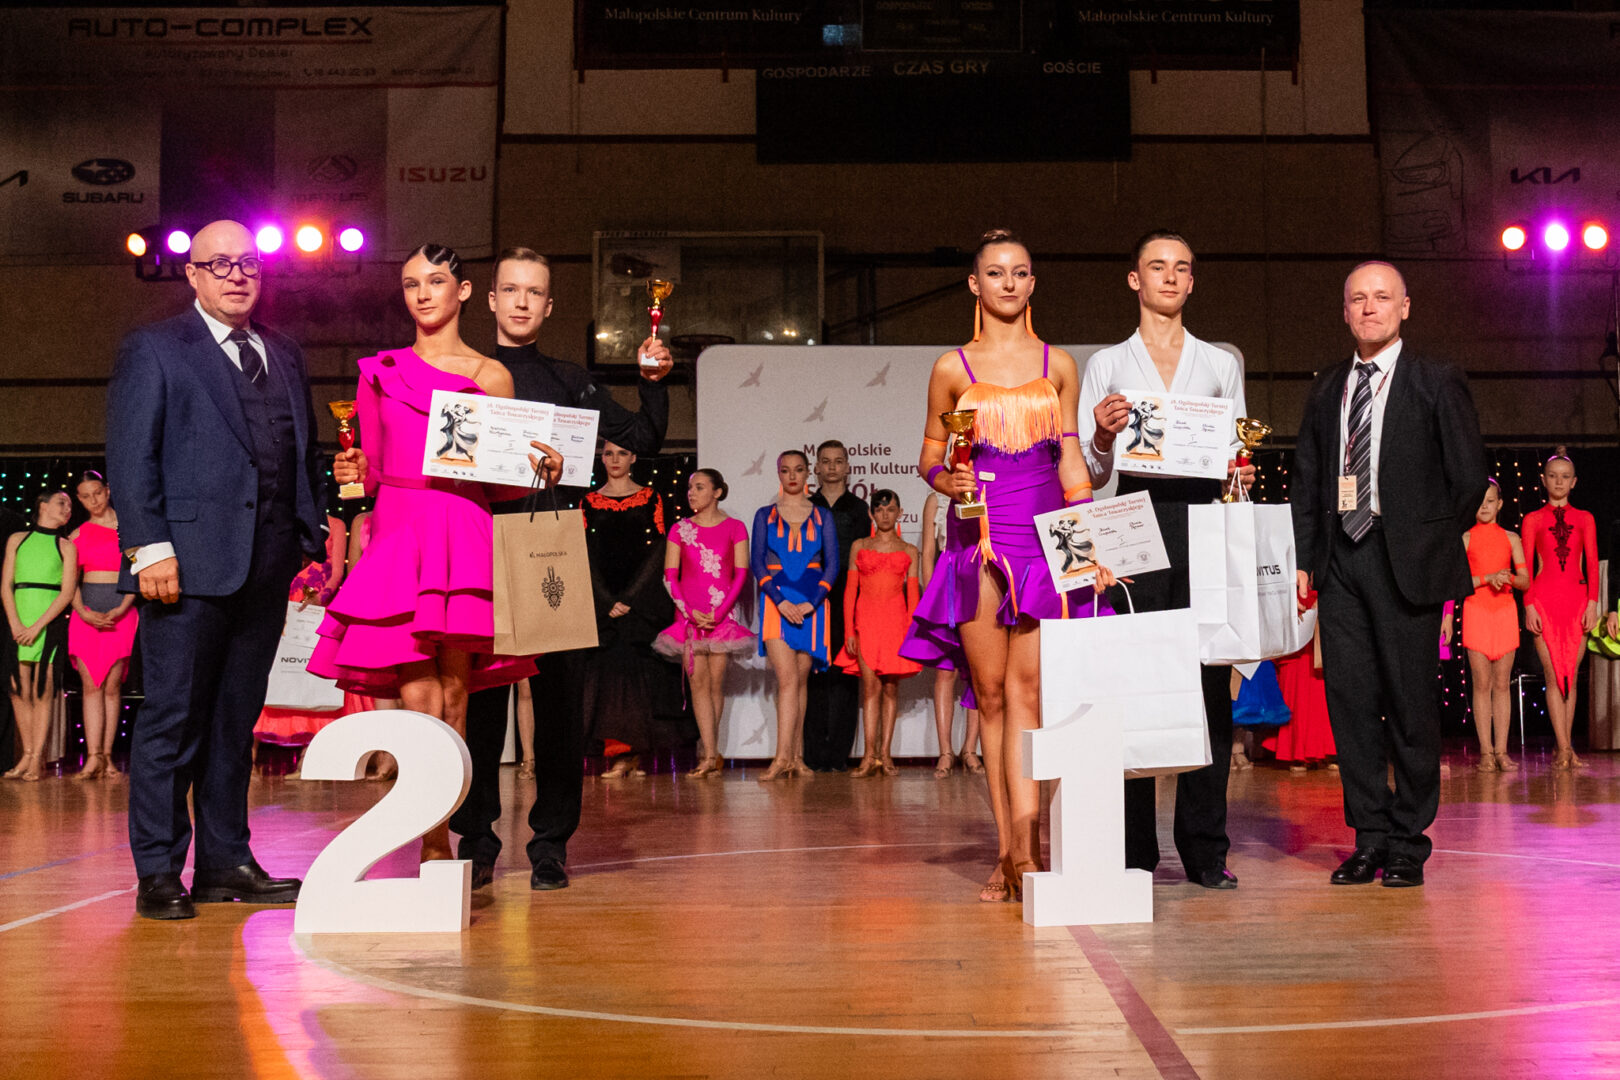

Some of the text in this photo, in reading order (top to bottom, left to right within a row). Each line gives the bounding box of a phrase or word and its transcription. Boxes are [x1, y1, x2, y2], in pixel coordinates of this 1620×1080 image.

[605, 8, 800, 24] Małopolskie Centrum Kultury
[1079, 10, 1275, 26] Małopolskie Centrum Kultury
[68, 17, 373, 37] AUTO-COMPLEX
[762, 66, 873, 79] GOSPODARZE
[893, 59, 990, 76] CZAS GRY
[1043, 59, 1100, 75] GOŚCIE
[399, 167, 487, 183] ISUZU
[1510, 167, 1580, 184] KIA
[62, 192, 144, 203] SUBARU
[804, 443, 892, 458] Molskie
[870, 461, 921, 478] Kultury
[281, 656, 310, 664] NOVI
[294, 709, 472, 933] 2
[1022, 702, 1153, 927] 1
